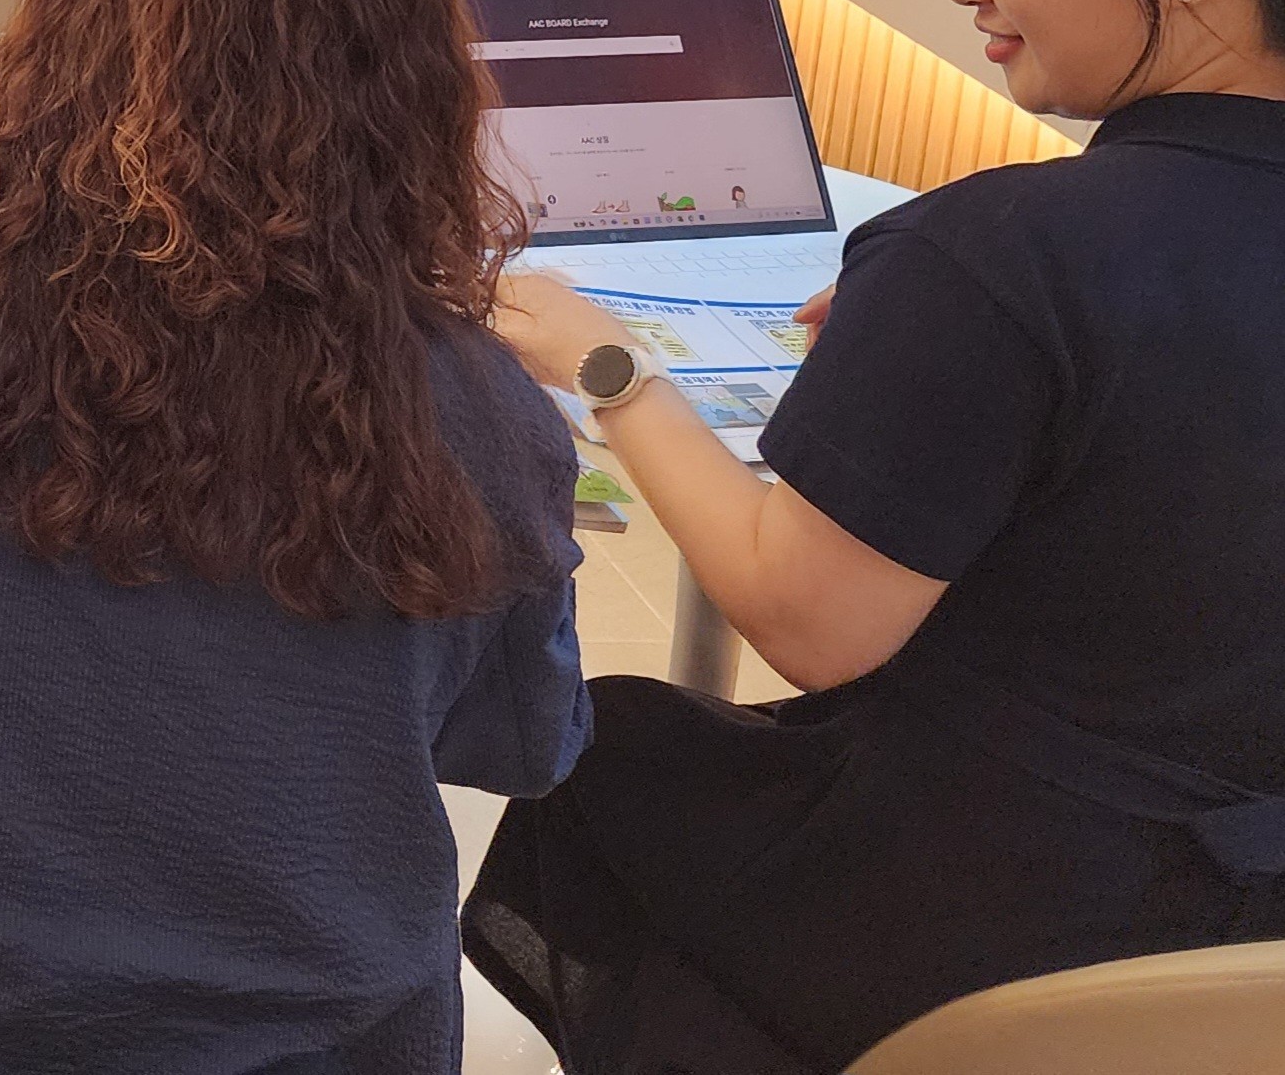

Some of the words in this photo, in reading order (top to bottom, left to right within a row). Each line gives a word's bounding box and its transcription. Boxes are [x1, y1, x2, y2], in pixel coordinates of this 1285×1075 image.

[529, 20, 545, 28] AAC
[545, 18, 572, 28] BOARD
[573, 17, 609, 28] Exchange
